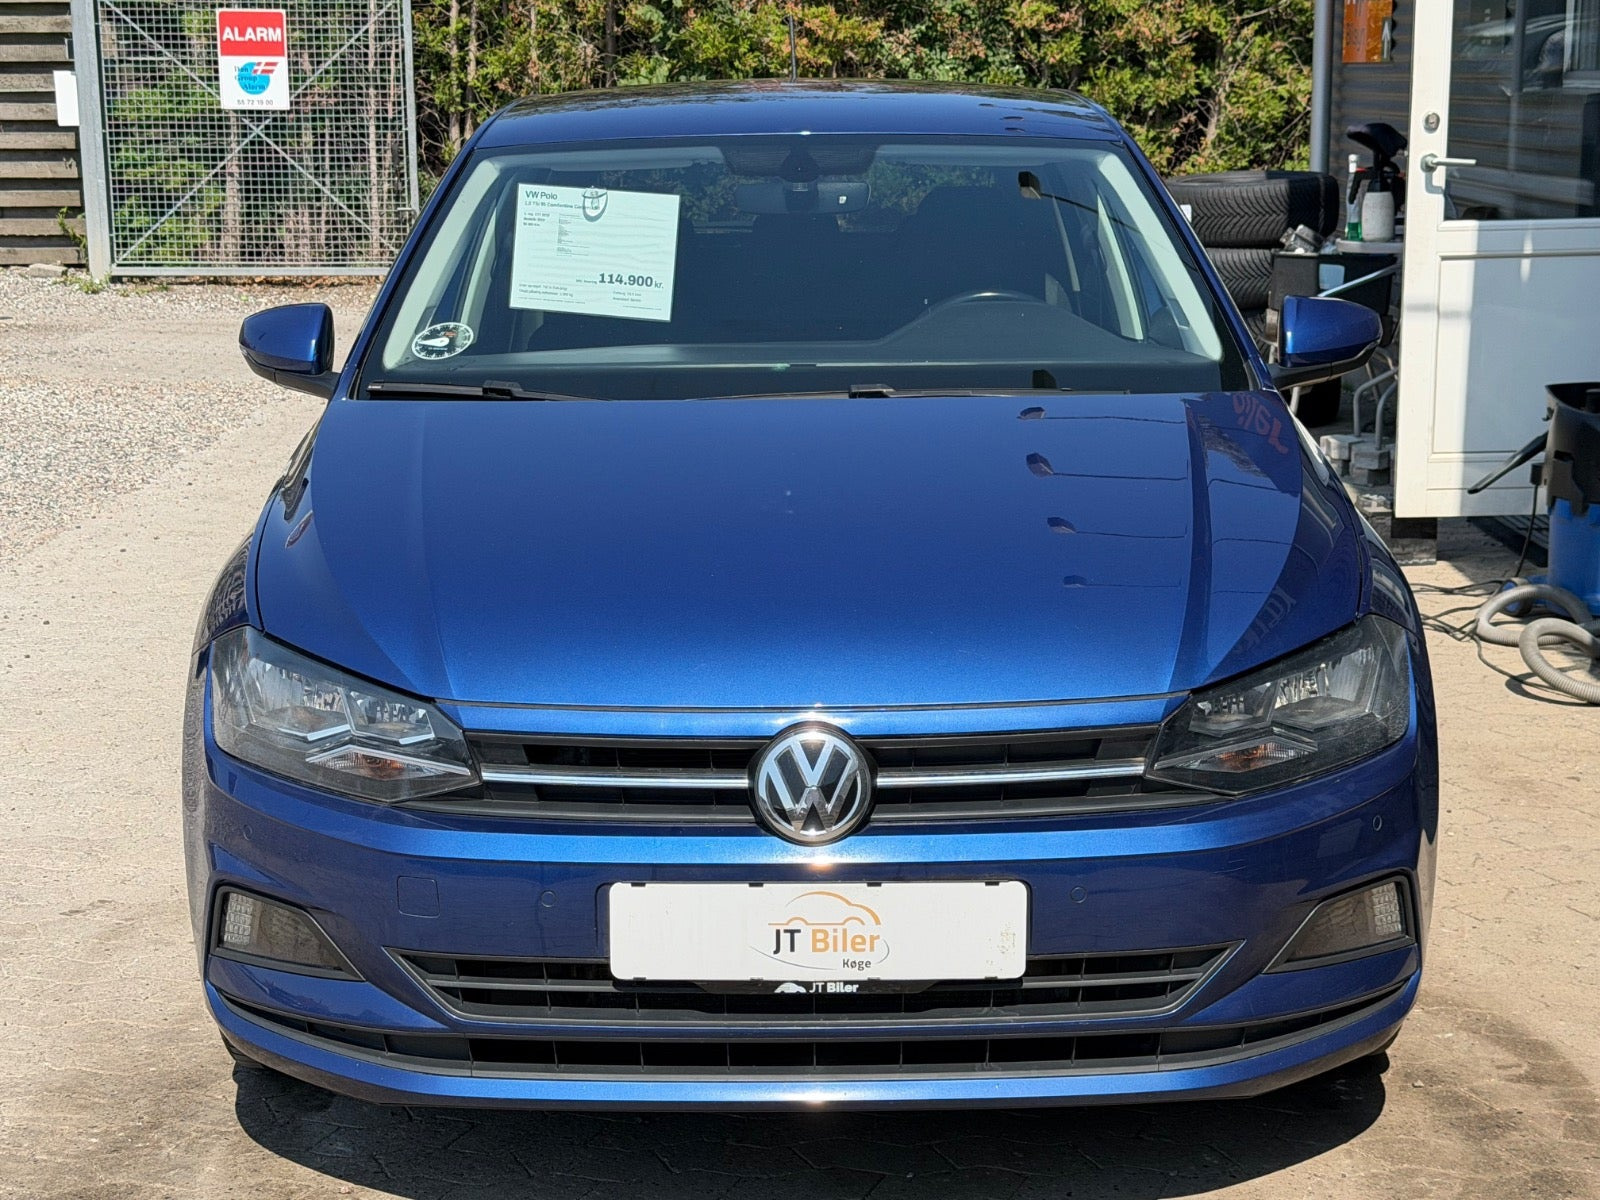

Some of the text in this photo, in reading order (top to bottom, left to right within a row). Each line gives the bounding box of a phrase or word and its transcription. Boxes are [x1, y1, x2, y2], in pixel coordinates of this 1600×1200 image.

[222, 26, 282, 42] ALARM
[525, 190, 558, 200] VW Polo
[598, 272, 653, 287] 114.900
[654, 280, 664, 289] kr.
[773, 928, 880, 955] JT Biler
[842, 958, 872, 971] Køge
[809, 982, 859, 993] JT Biler
